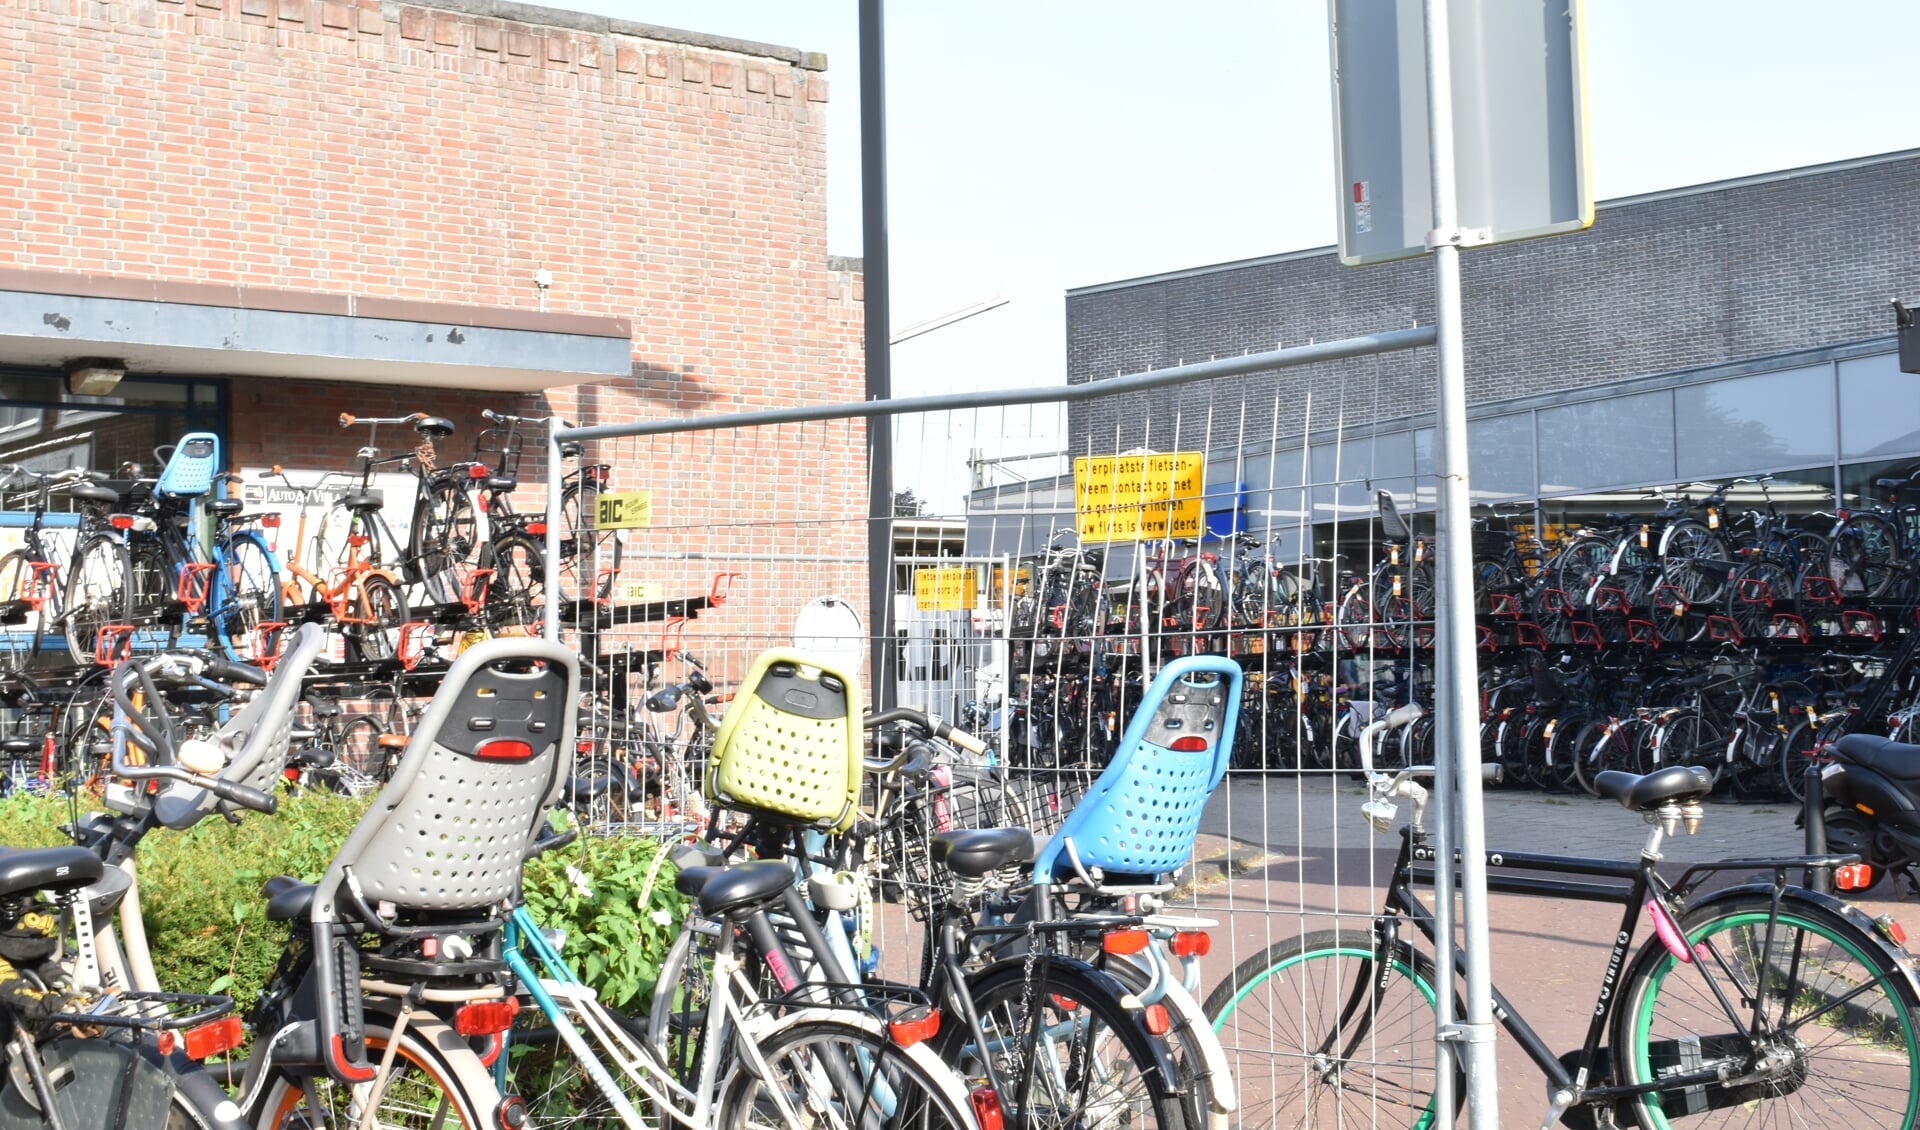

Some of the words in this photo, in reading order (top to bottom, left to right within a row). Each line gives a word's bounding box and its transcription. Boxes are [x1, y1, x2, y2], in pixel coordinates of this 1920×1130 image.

[1114, 480, 1152, 493] ontact
[1156, 481, 1168, 494] op
[1127, 519, 1137, 531] is
[1604, 946, 1624, 984] UNION
